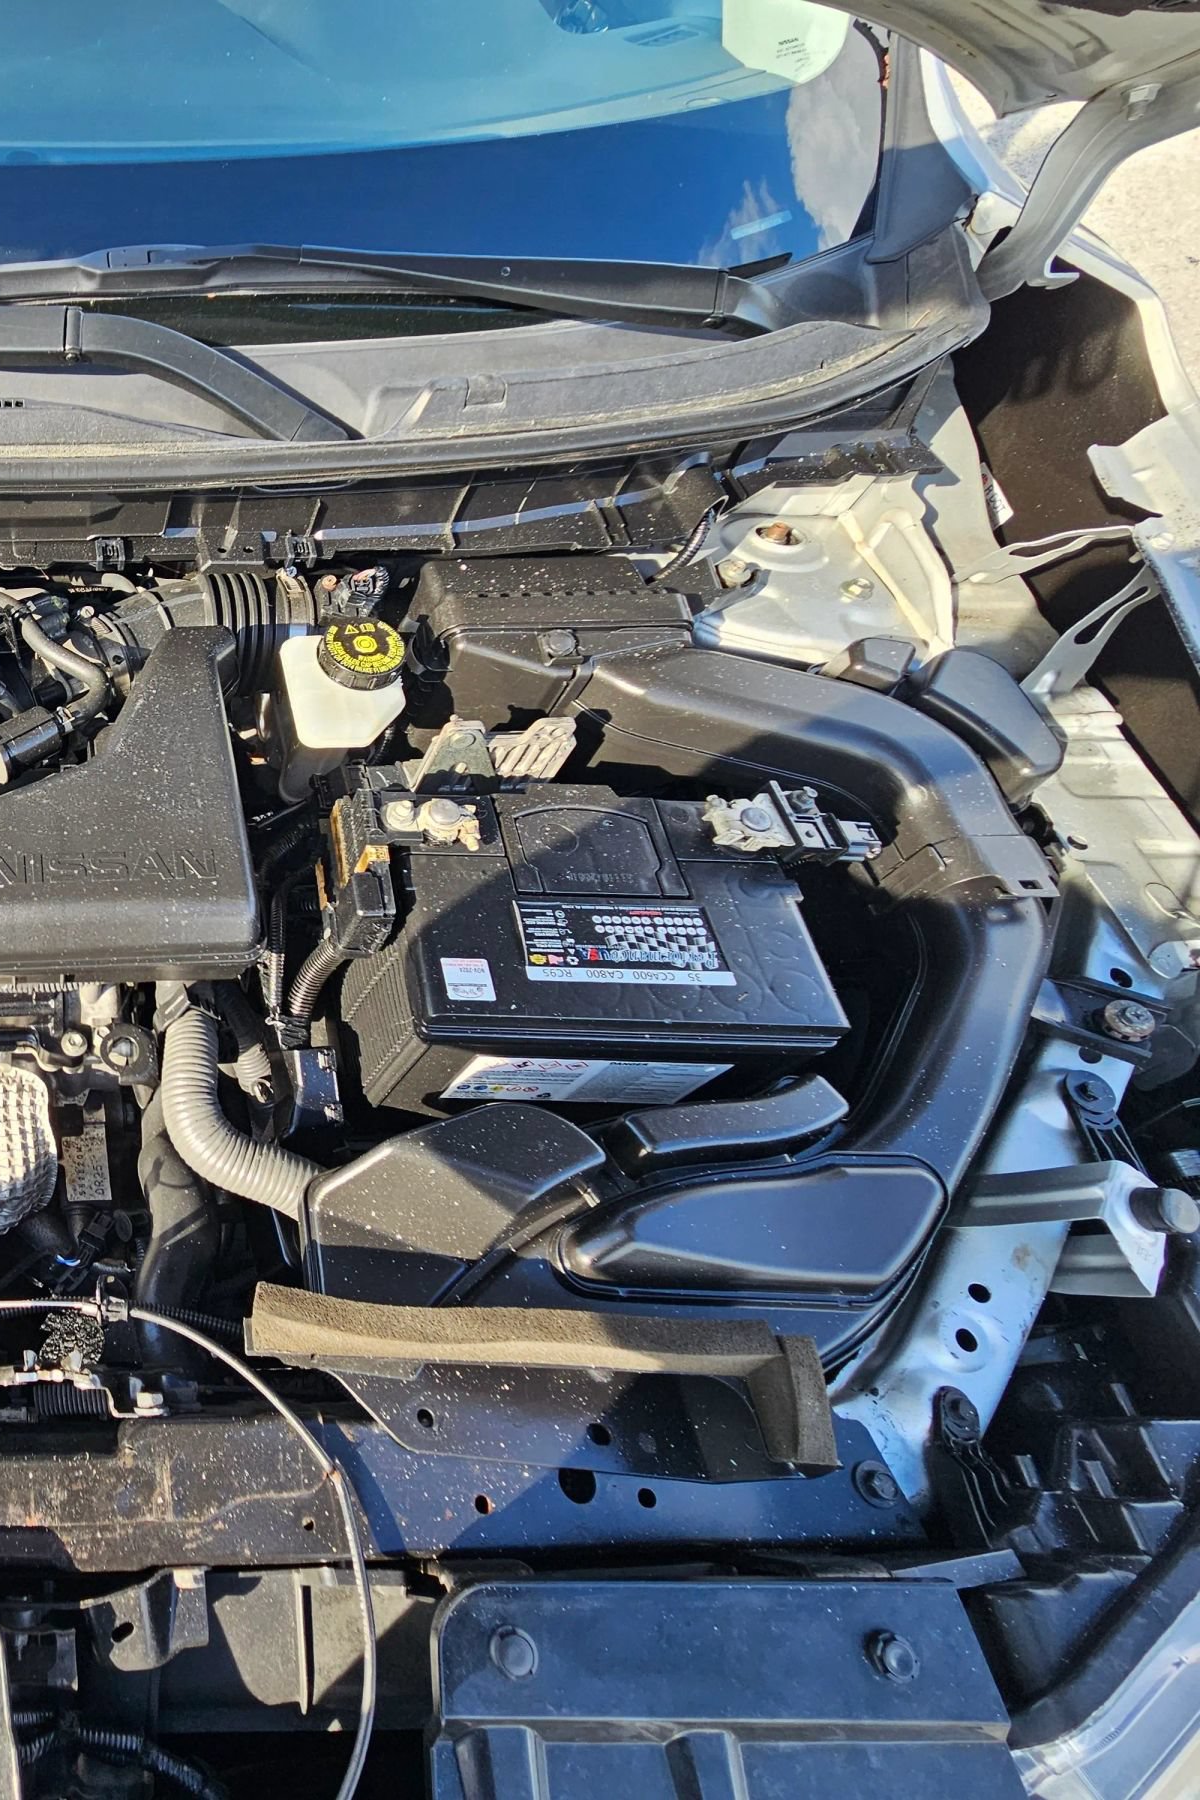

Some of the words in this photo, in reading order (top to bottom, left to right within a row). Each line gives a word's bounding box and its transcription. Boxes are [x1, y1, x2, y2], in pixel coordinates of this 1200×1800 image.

[576, 948, 610, 963] USA
[543, 969, 571, 978] RC95
[586, 969, 623, 979] CA800
[632, 970, 675, 981] CCA600
[688, 973, 702, 982] 35
